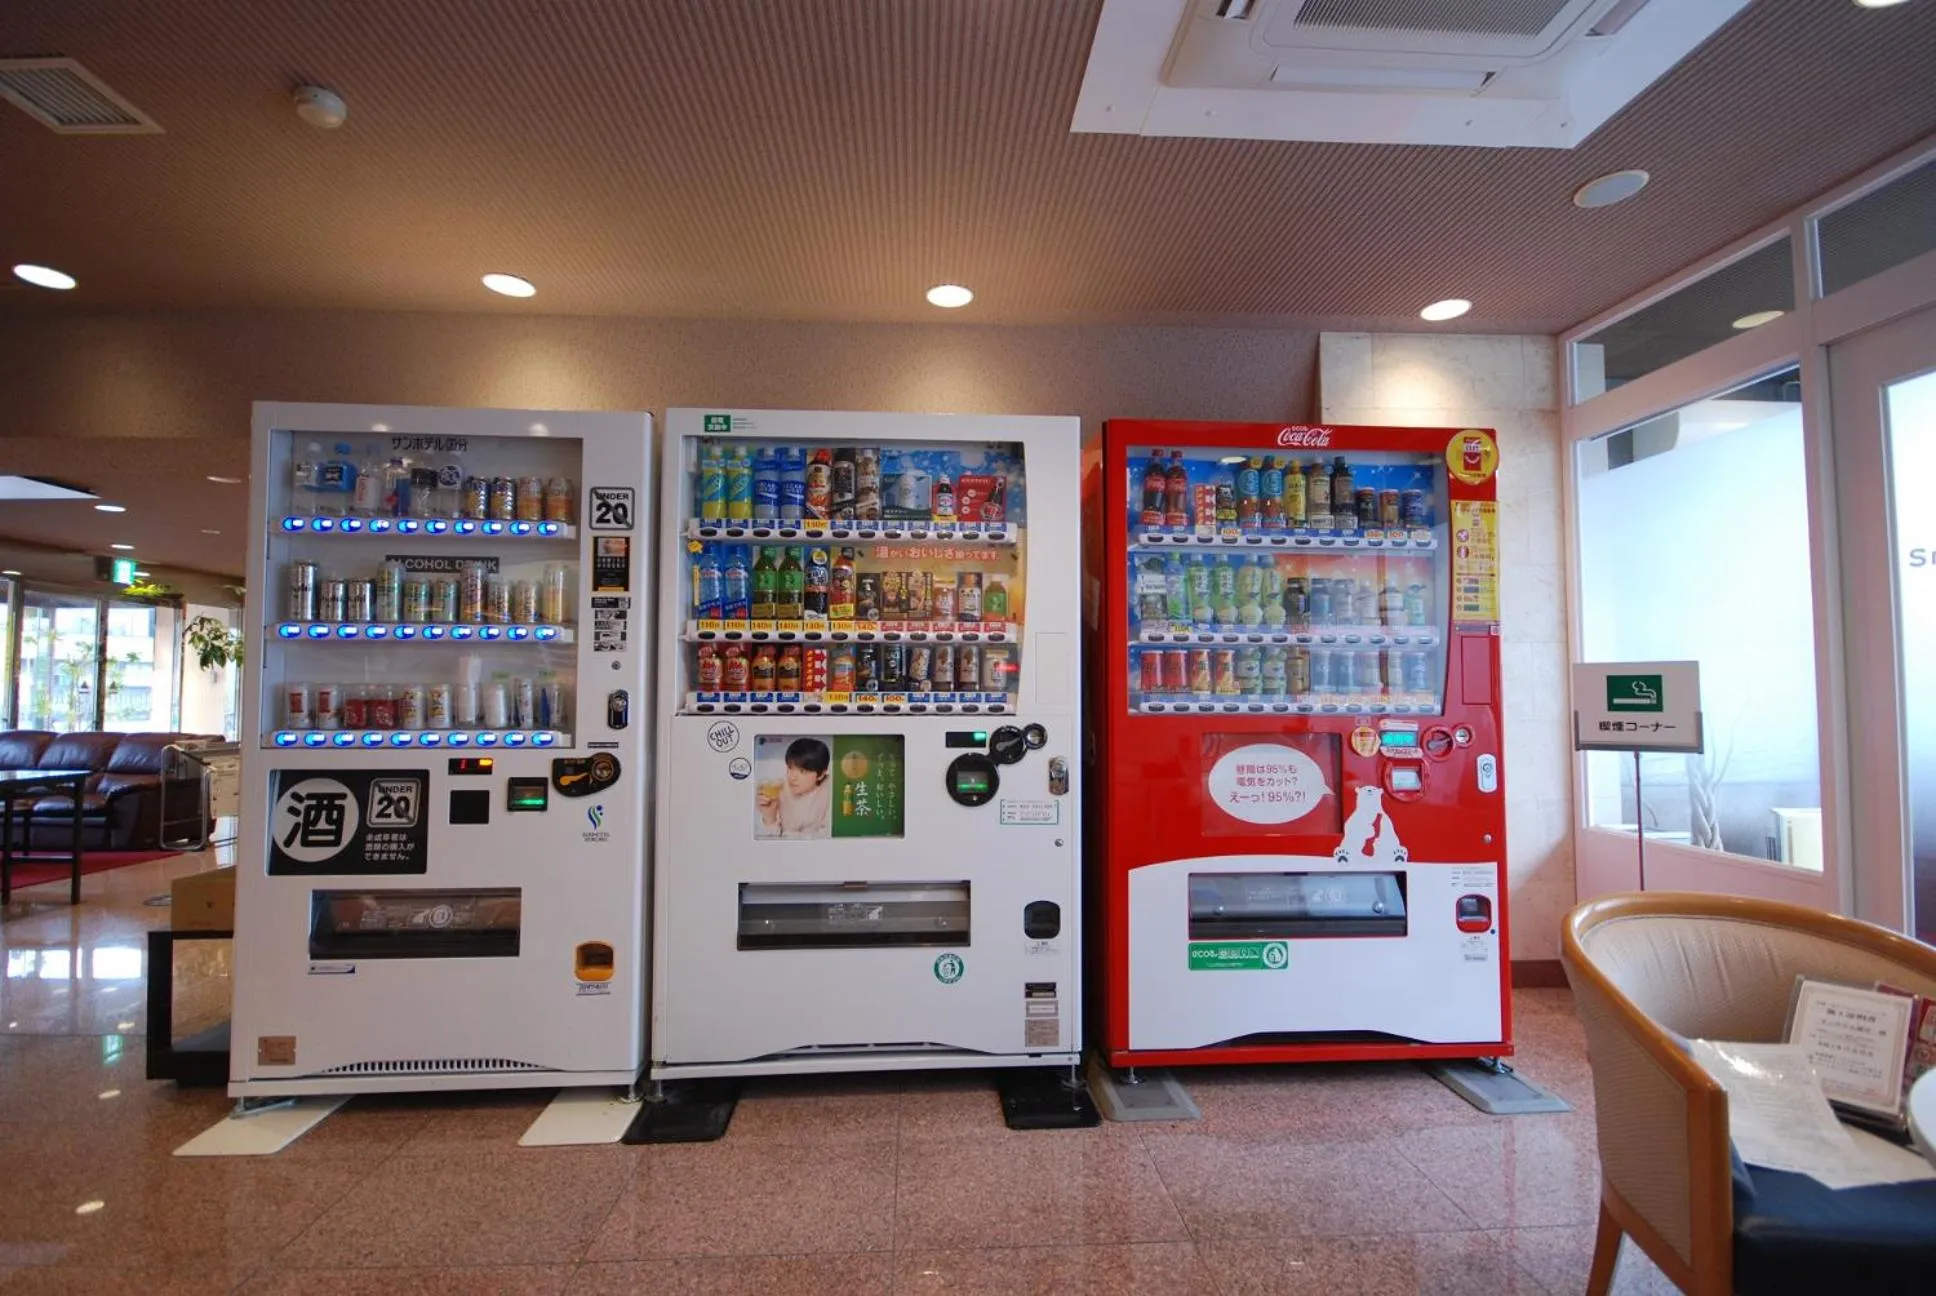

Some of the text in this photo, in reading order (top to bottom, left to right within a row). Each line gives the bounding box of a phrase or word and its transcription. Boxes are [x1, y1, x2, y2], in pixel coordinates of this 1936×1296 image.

[595, 502, 628, 524] 20
[709, 726, 735, 741] CHILL
[1599, 721, 1676, 732] 喫煙コーナー
[716, 736, 734, 748] OUT
[375, 796, 411, 819] 20
[854, 780, 872, 816] 生茶
[282, 791, 347, 848] 酒
